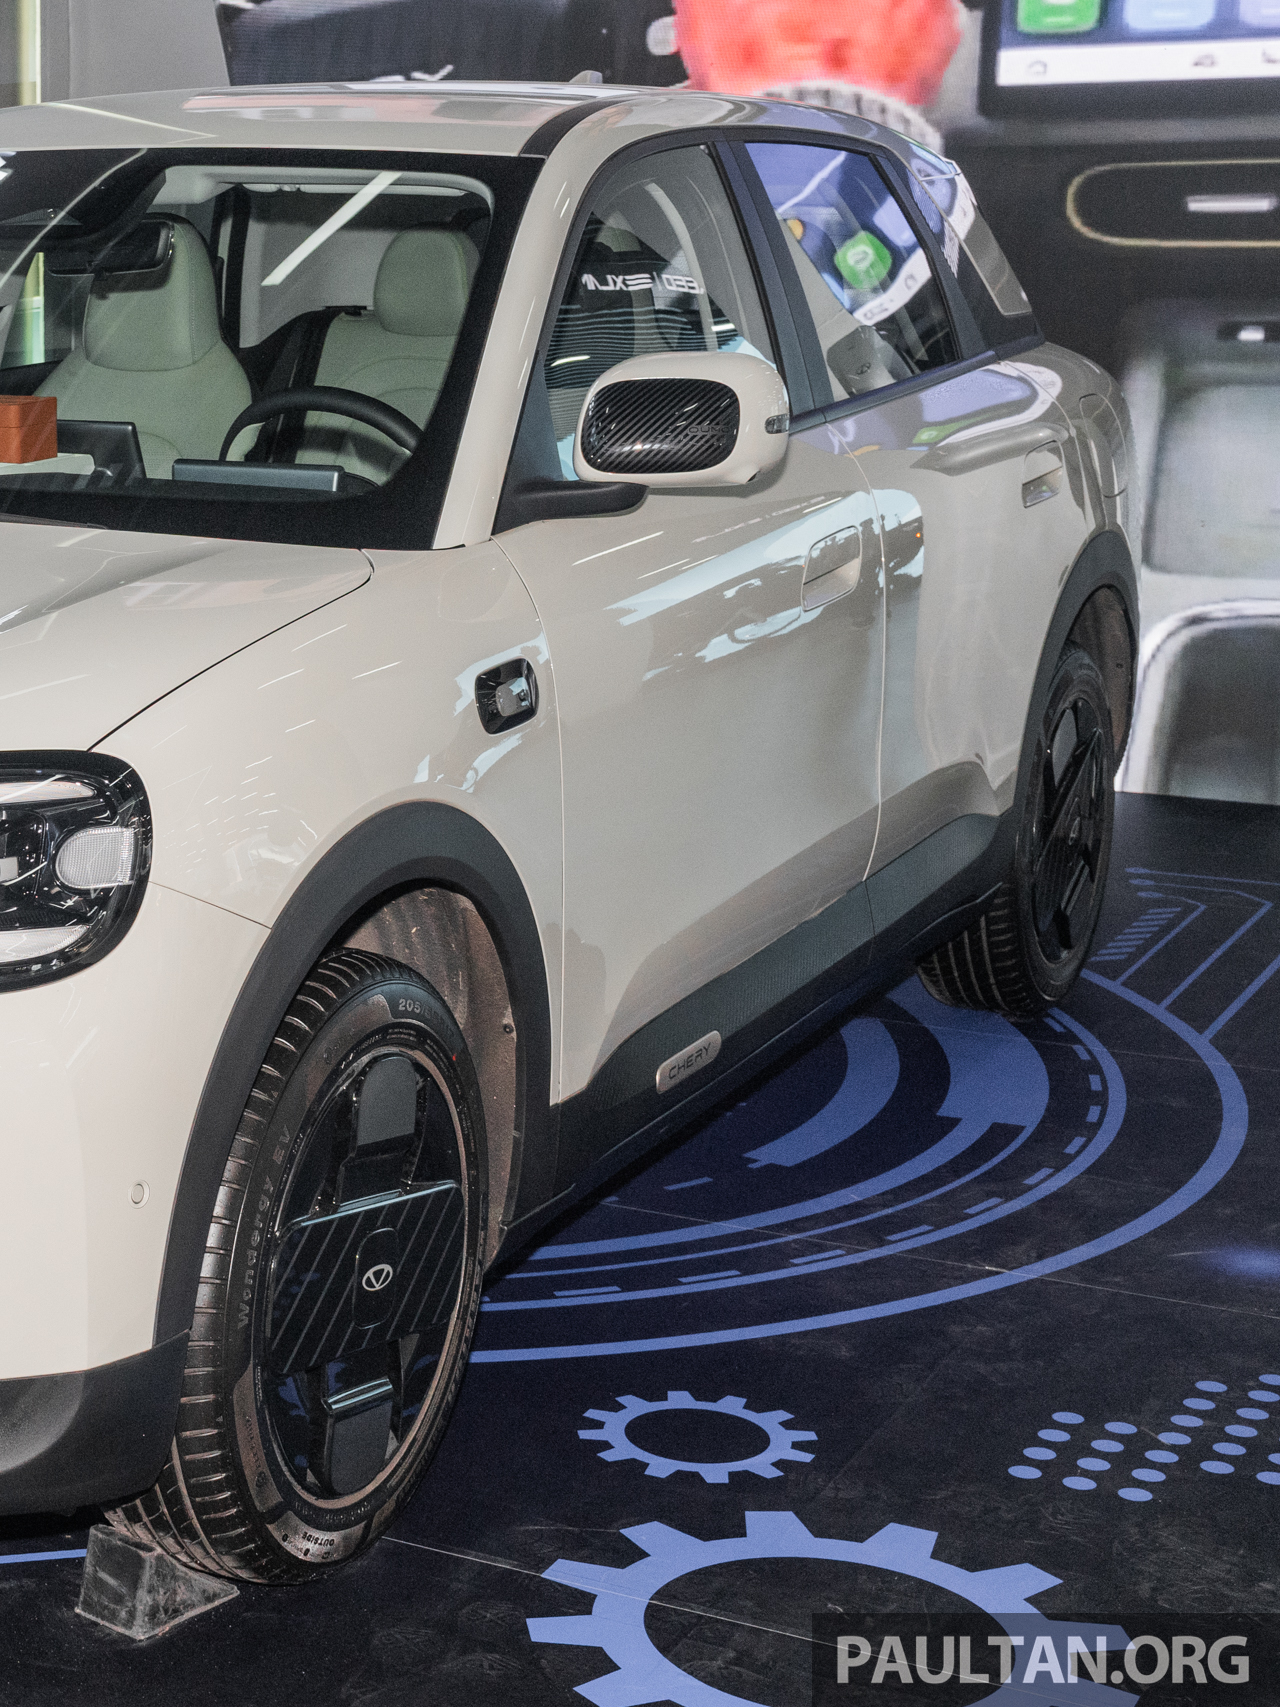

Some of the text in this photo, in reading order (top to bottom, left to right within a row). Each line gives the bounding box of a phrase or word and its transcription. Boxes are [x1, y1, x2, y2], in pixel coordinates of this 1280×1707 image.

[668, 1041, 712, 1080] CHERY
[272, 1124, 293, 1166] EV
[301, 1531, 336, 1548] OUTSIDE
